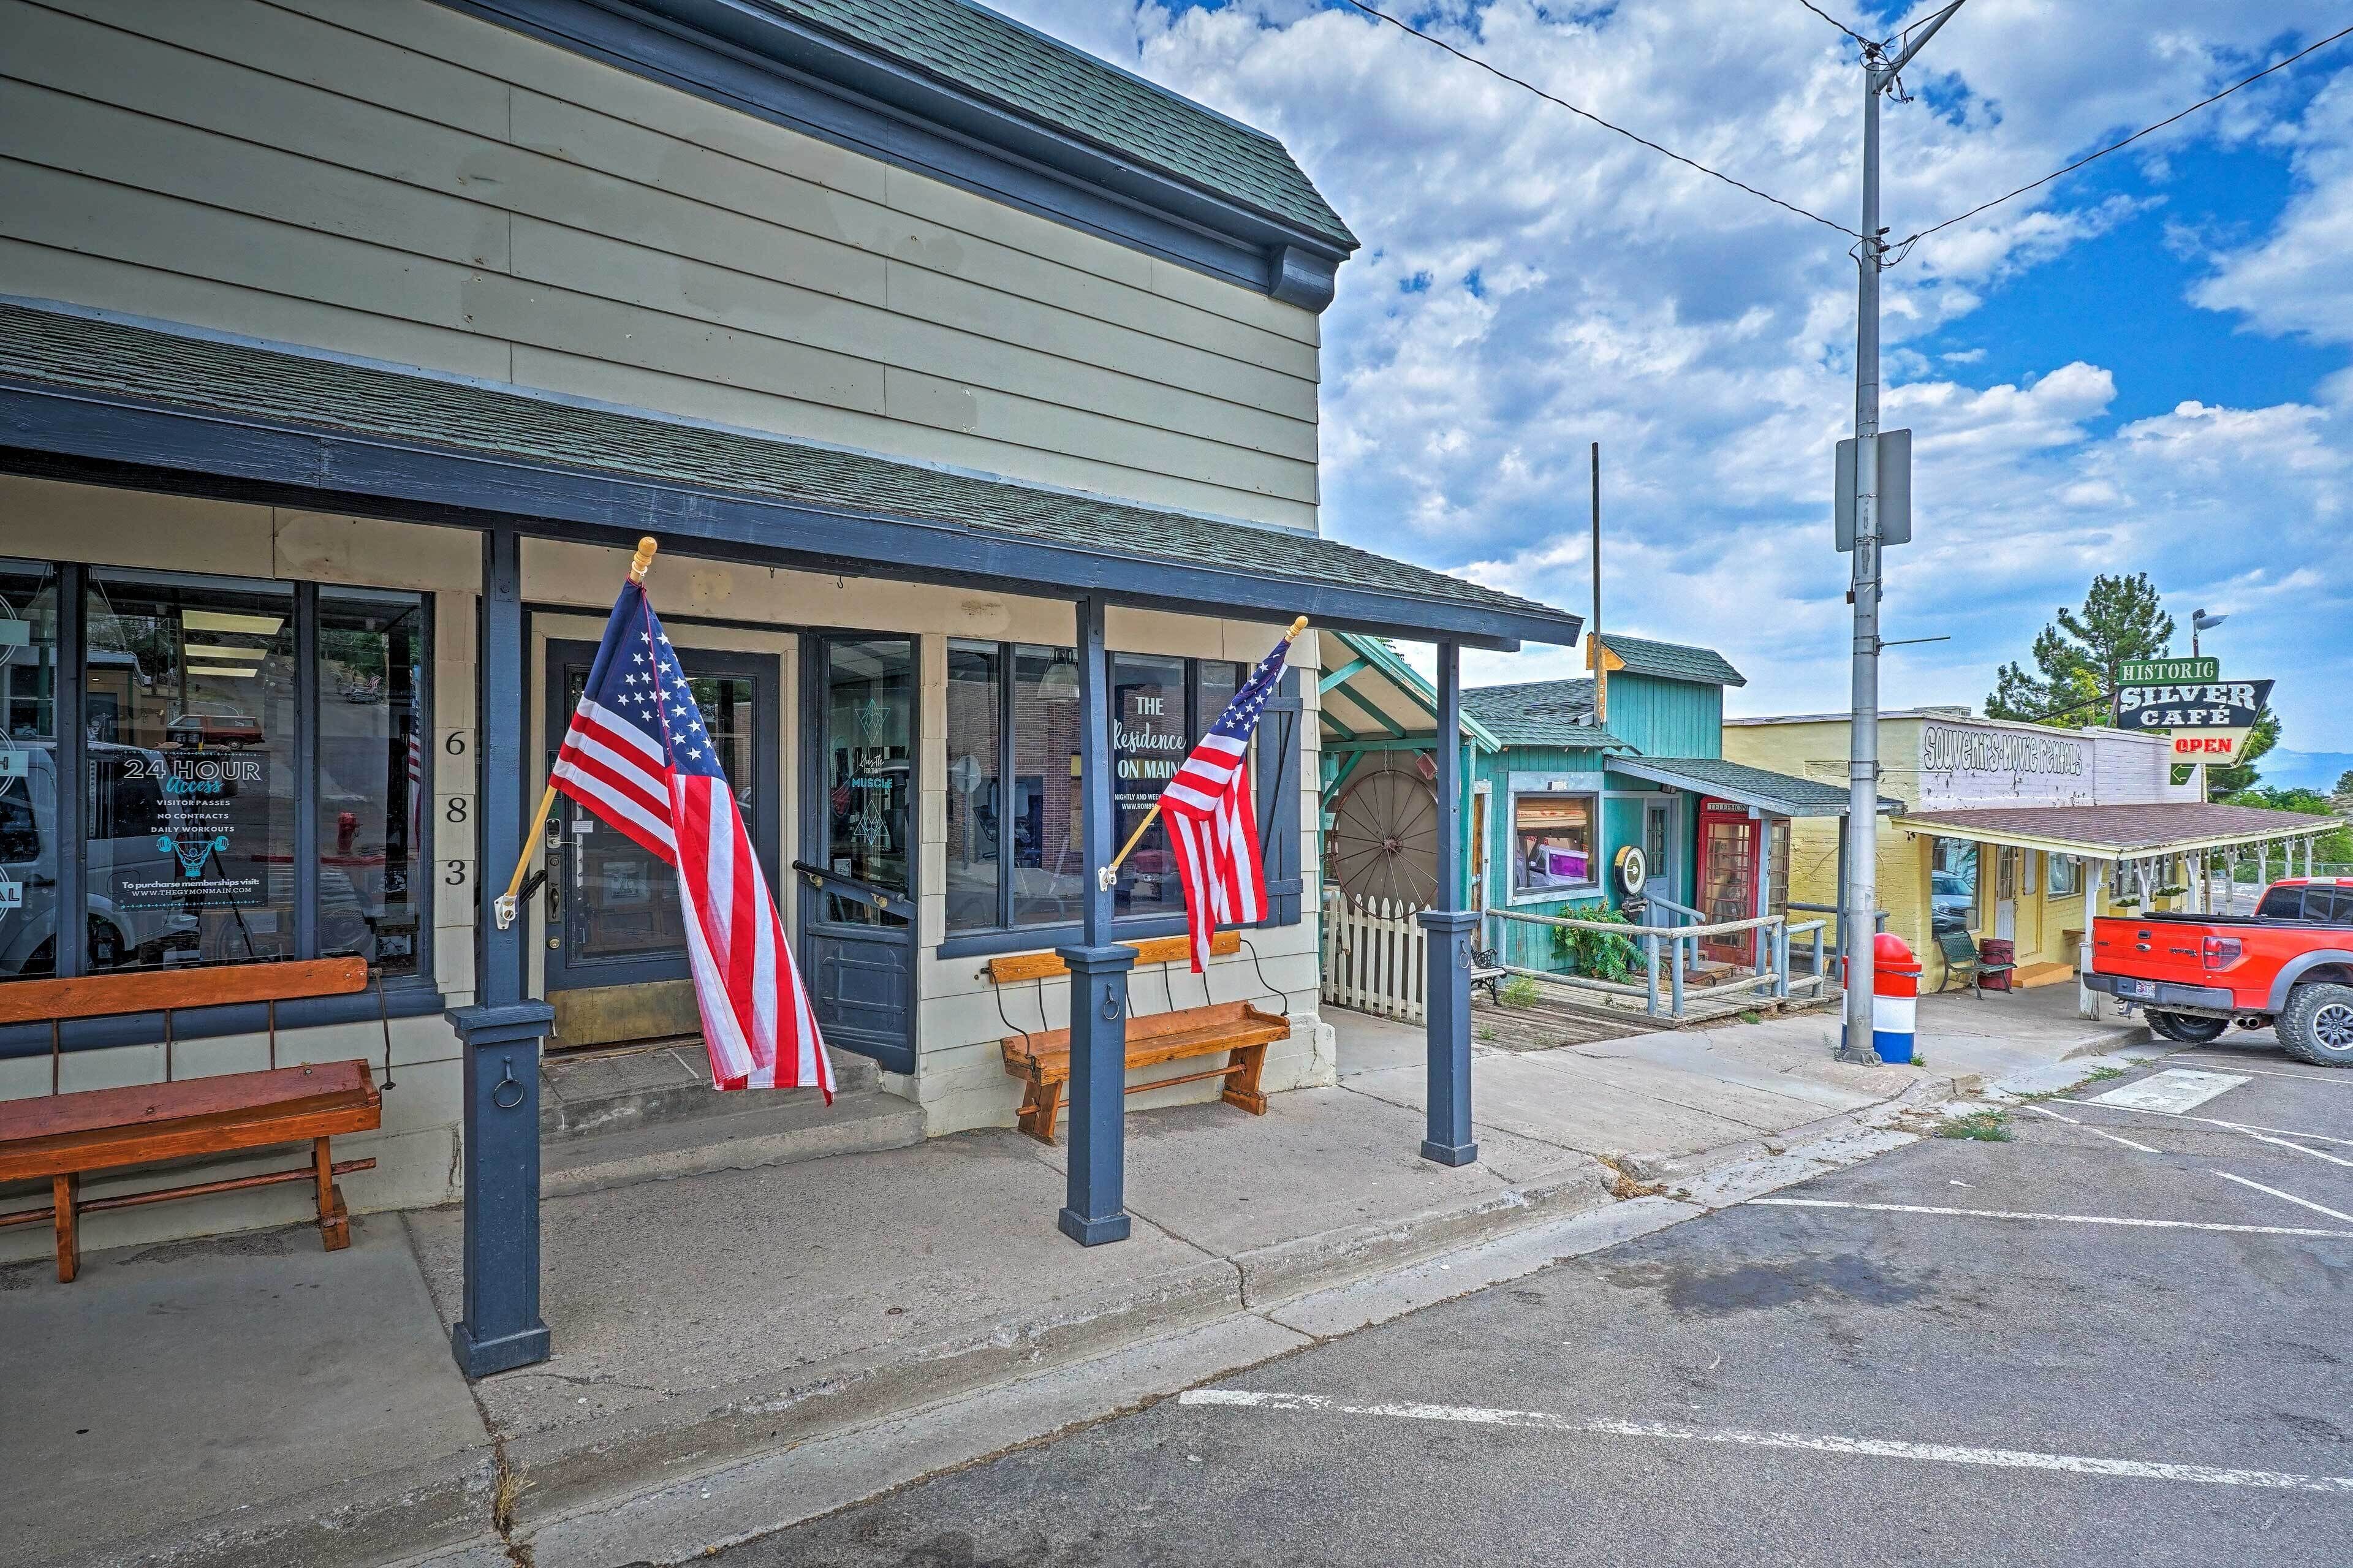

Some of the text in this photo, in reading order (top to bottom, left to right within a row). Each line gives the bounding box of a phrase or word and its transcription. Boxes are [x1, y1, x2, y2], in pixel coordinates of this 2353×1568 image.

[2122, 662, 2214, 681] HISTORIC
[1135, 696, 1164, 716] THE
[2120, 684, 2256, 713] SILVER
[2140, 705, 2230, 725] CAFÉ
[1114, 719, 1187, 753] Residence
[2175, 738, 2232, 753] OPEN
[124, 759, 262, 781] 24 HOUR
[1118, 760, 1180, 779] ON MAIN
[852, 778, 893, 788] MUSCLE
[131, 888, 252, 897] WWW.THEGYMONMAIN.COM
[135, 880, 181, 890] purcharse
[182, 879, 239, 887] memberships
